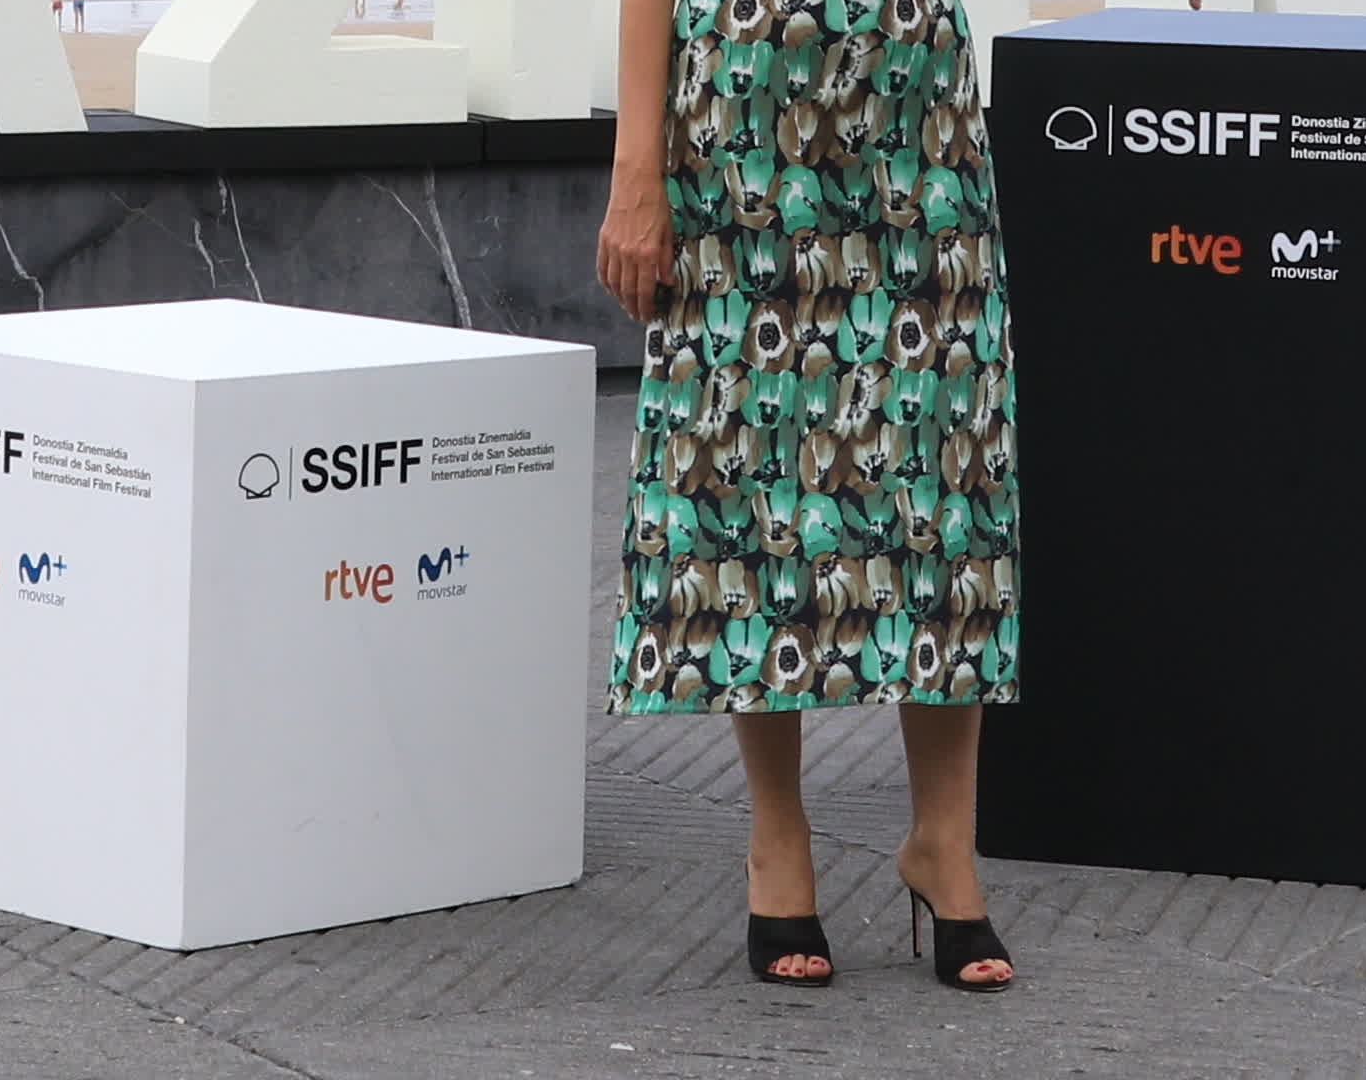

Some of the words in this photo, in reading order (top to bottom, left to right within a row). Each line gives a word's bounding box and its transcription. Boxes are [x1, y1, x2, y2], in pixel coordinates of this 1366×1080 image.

[1123, 108, 1281, 157] SSIFF
[1291, 115, 1350, 129] Donostia
[1291, 131, 1341, 145] Festival
[1344, 133, 1361, 145] de
[1151, 225, 1242, 274] rtve
[1271, 266, 1339, 281] movistar
[33, 434, 74, 451] Donostia
[77, 441, 128, 460] Zinemaldia
[432, 435, 476, 448] Donostia
[478, 429, 531, 444] Zinemaldia
[32, 451, 68, 468] Festival
[70, 458, 82, 469] de
[84, 460, 102, 473] San
[432, 451, 469, 465] Festival
[471, 450, 484, 461] de
[486, 448, 505, 460] San
[507, 444, 555, 458] Sebastián
[302, 438, 424, 493] SSIFF
[431, 465, 492, 481] International
[495, 463, 515, 475] Film
[517, 460, 554, 472] Festival
[32, 468, 91, 488] International
[93, 478, 112, 491] Film
[115, 482, 151, 498] Festival
[325, 560, 394, 603] rtve
[417, 584, 467, 600] movistar
[18, 588, 65, 606] movistar
